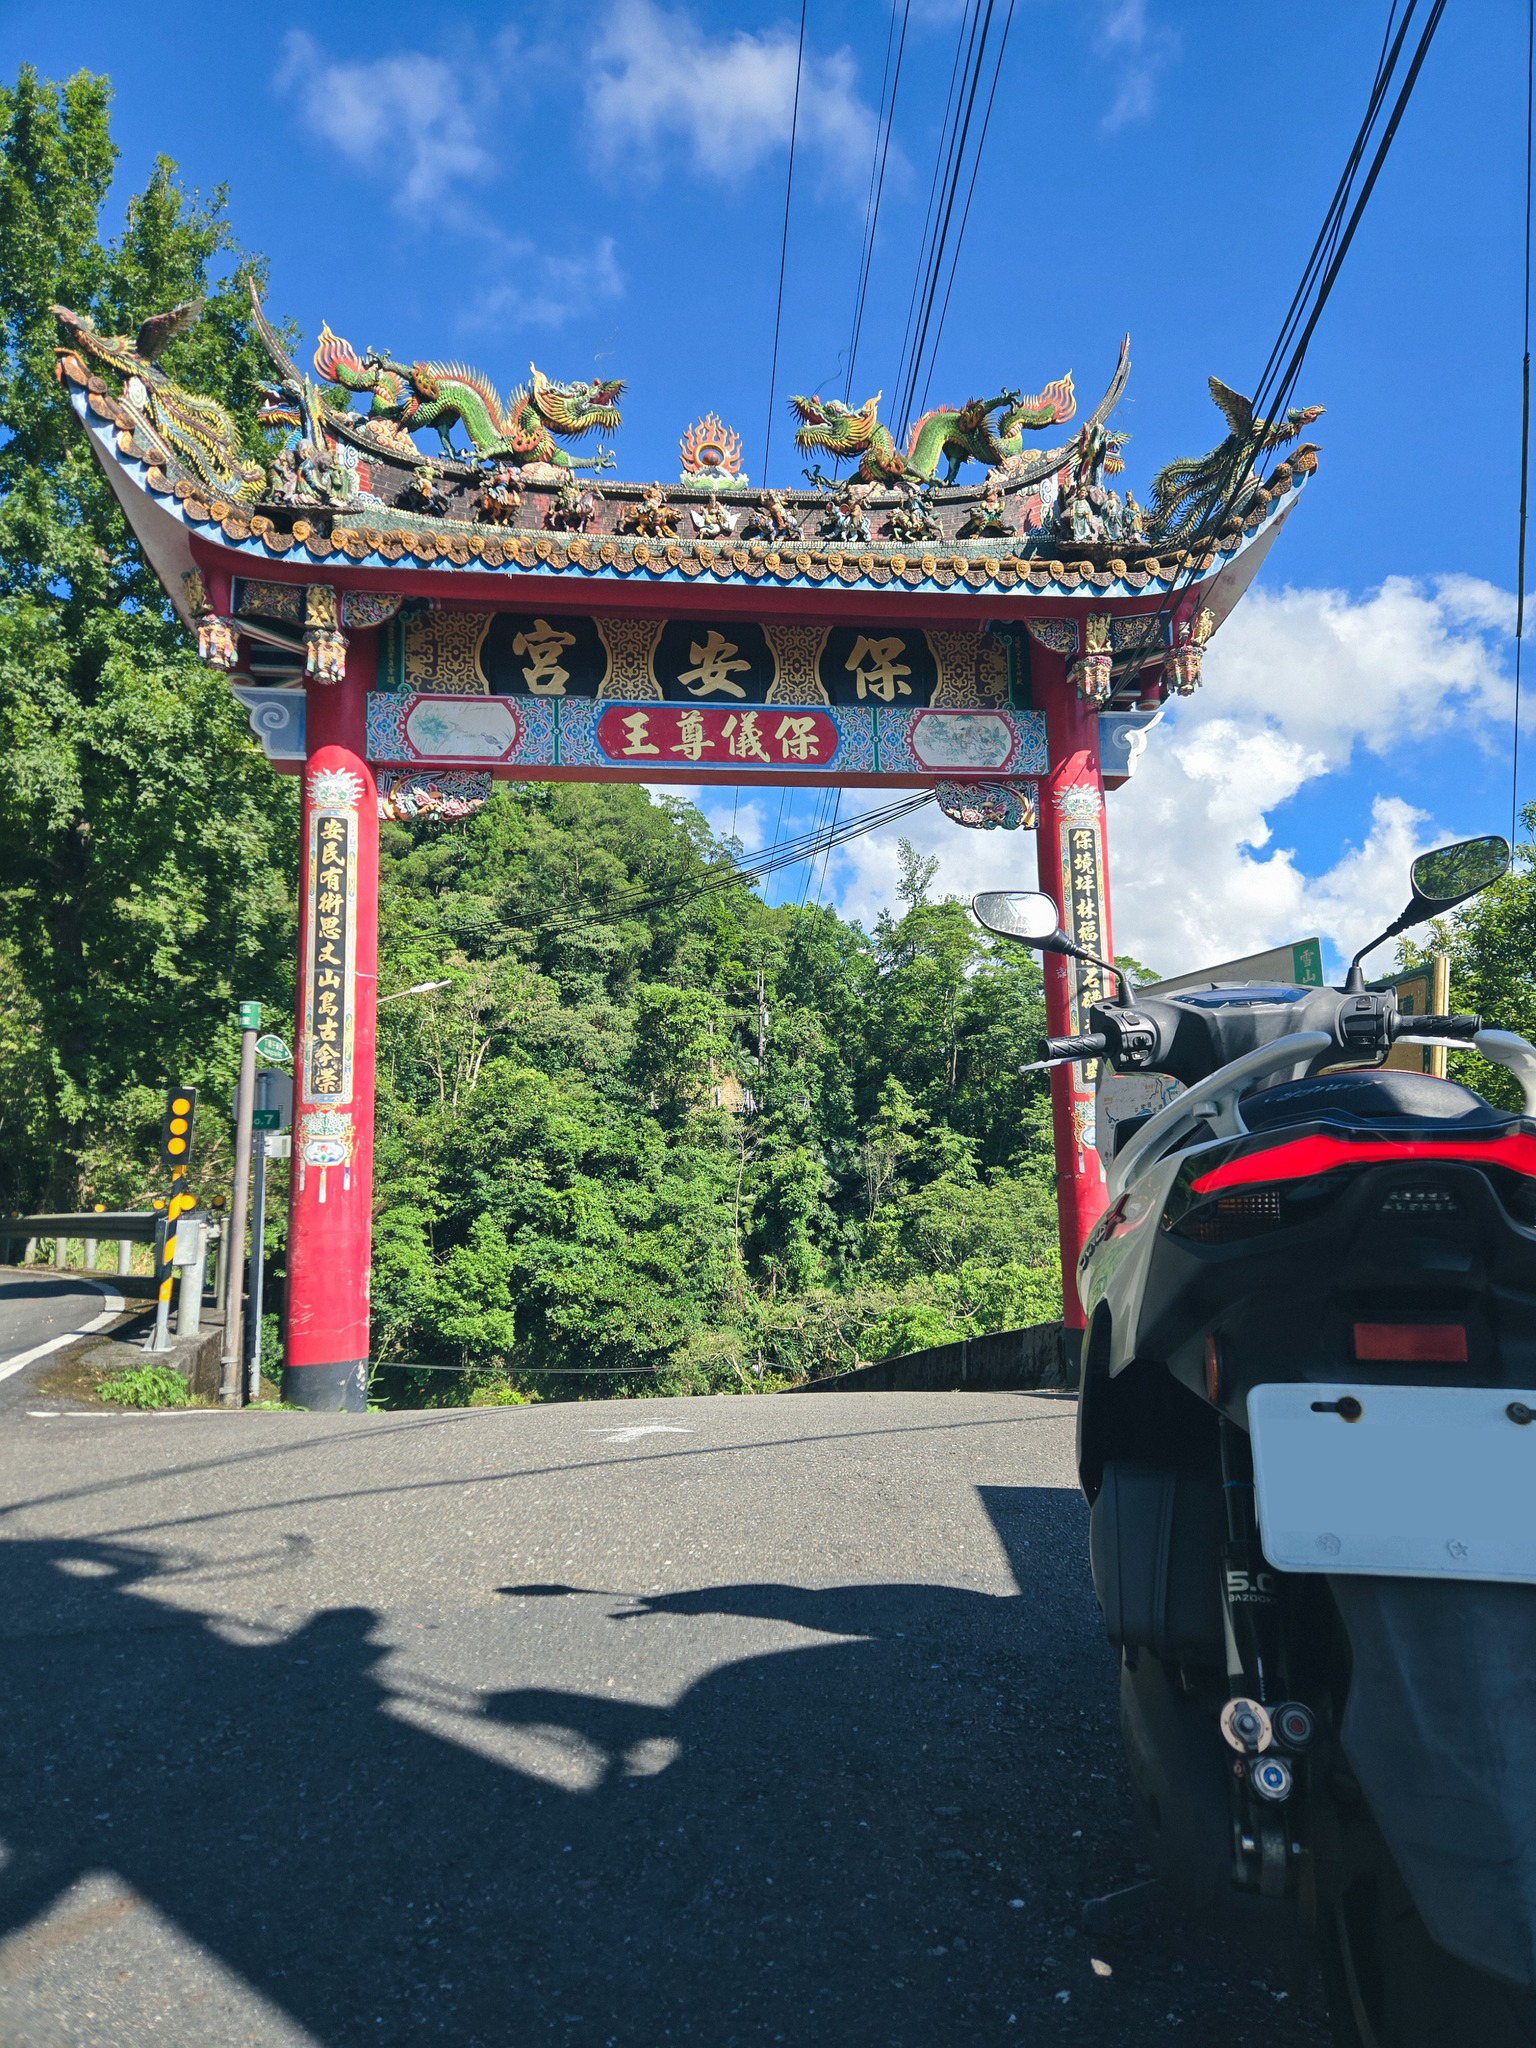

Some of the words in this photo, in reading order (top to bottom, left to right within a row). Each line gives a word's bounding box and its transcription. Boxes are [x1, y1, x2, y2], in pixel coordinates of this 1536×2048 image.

[512, 618, 914, 702] 保安宮
[620, 715, 821, 763] 保儀尊王
[1300, 950, 1316, 984] 雪山
[253, 1114, 275, 1126] o.7
